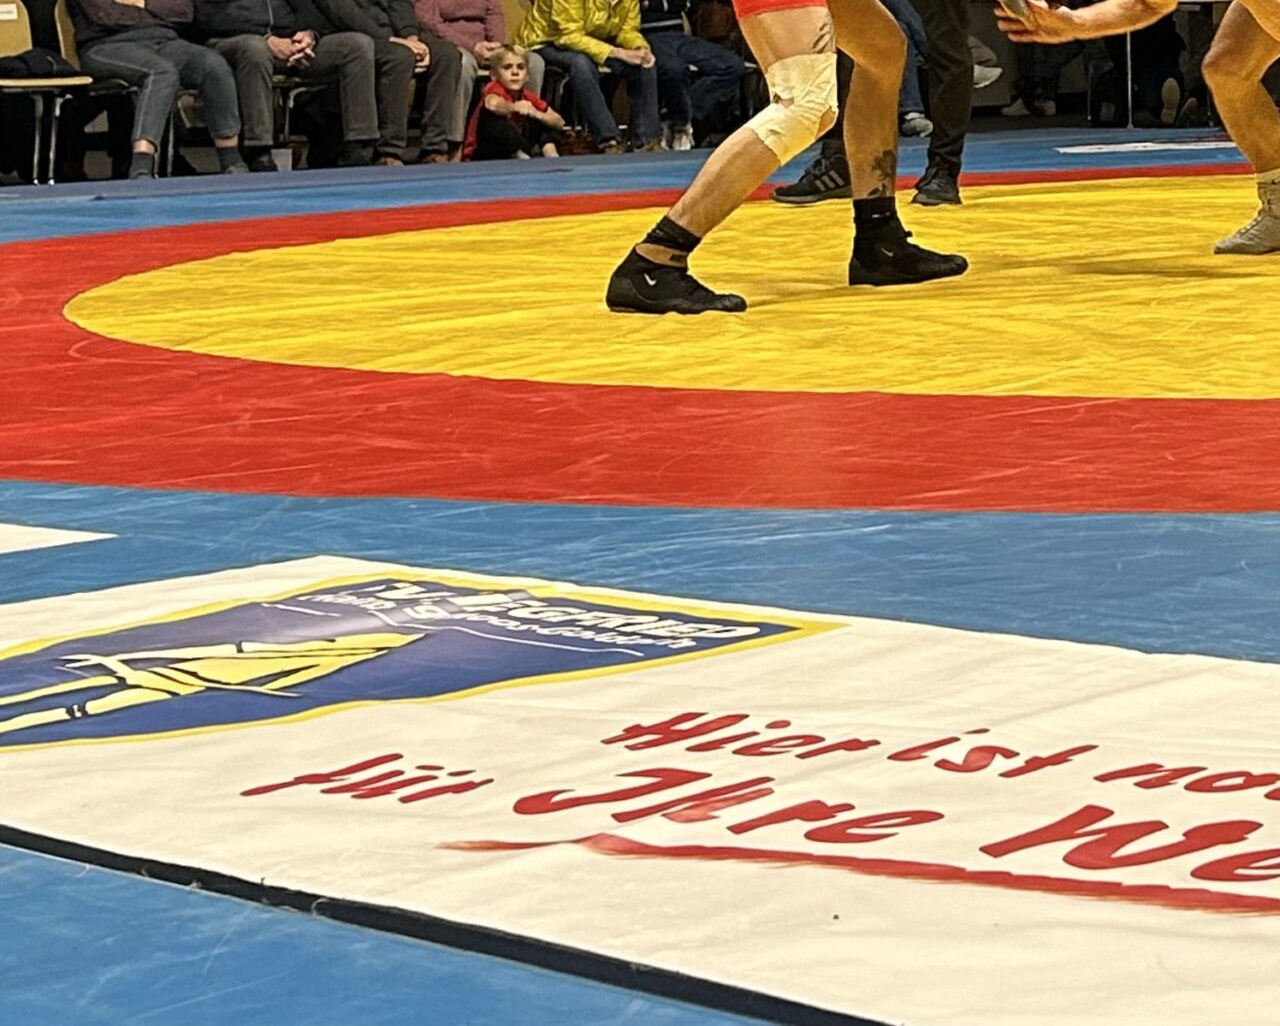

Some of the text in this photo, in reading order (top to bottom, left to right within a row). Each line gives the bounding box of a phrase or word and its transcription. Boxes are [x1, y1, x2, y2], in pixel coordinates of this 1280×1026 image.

[600, 711, 881, 759] Hier
[886, 727, 1100, 777] ist
[239, 752, 495, 804] für
[512, 767, 945, 842] Ihre
